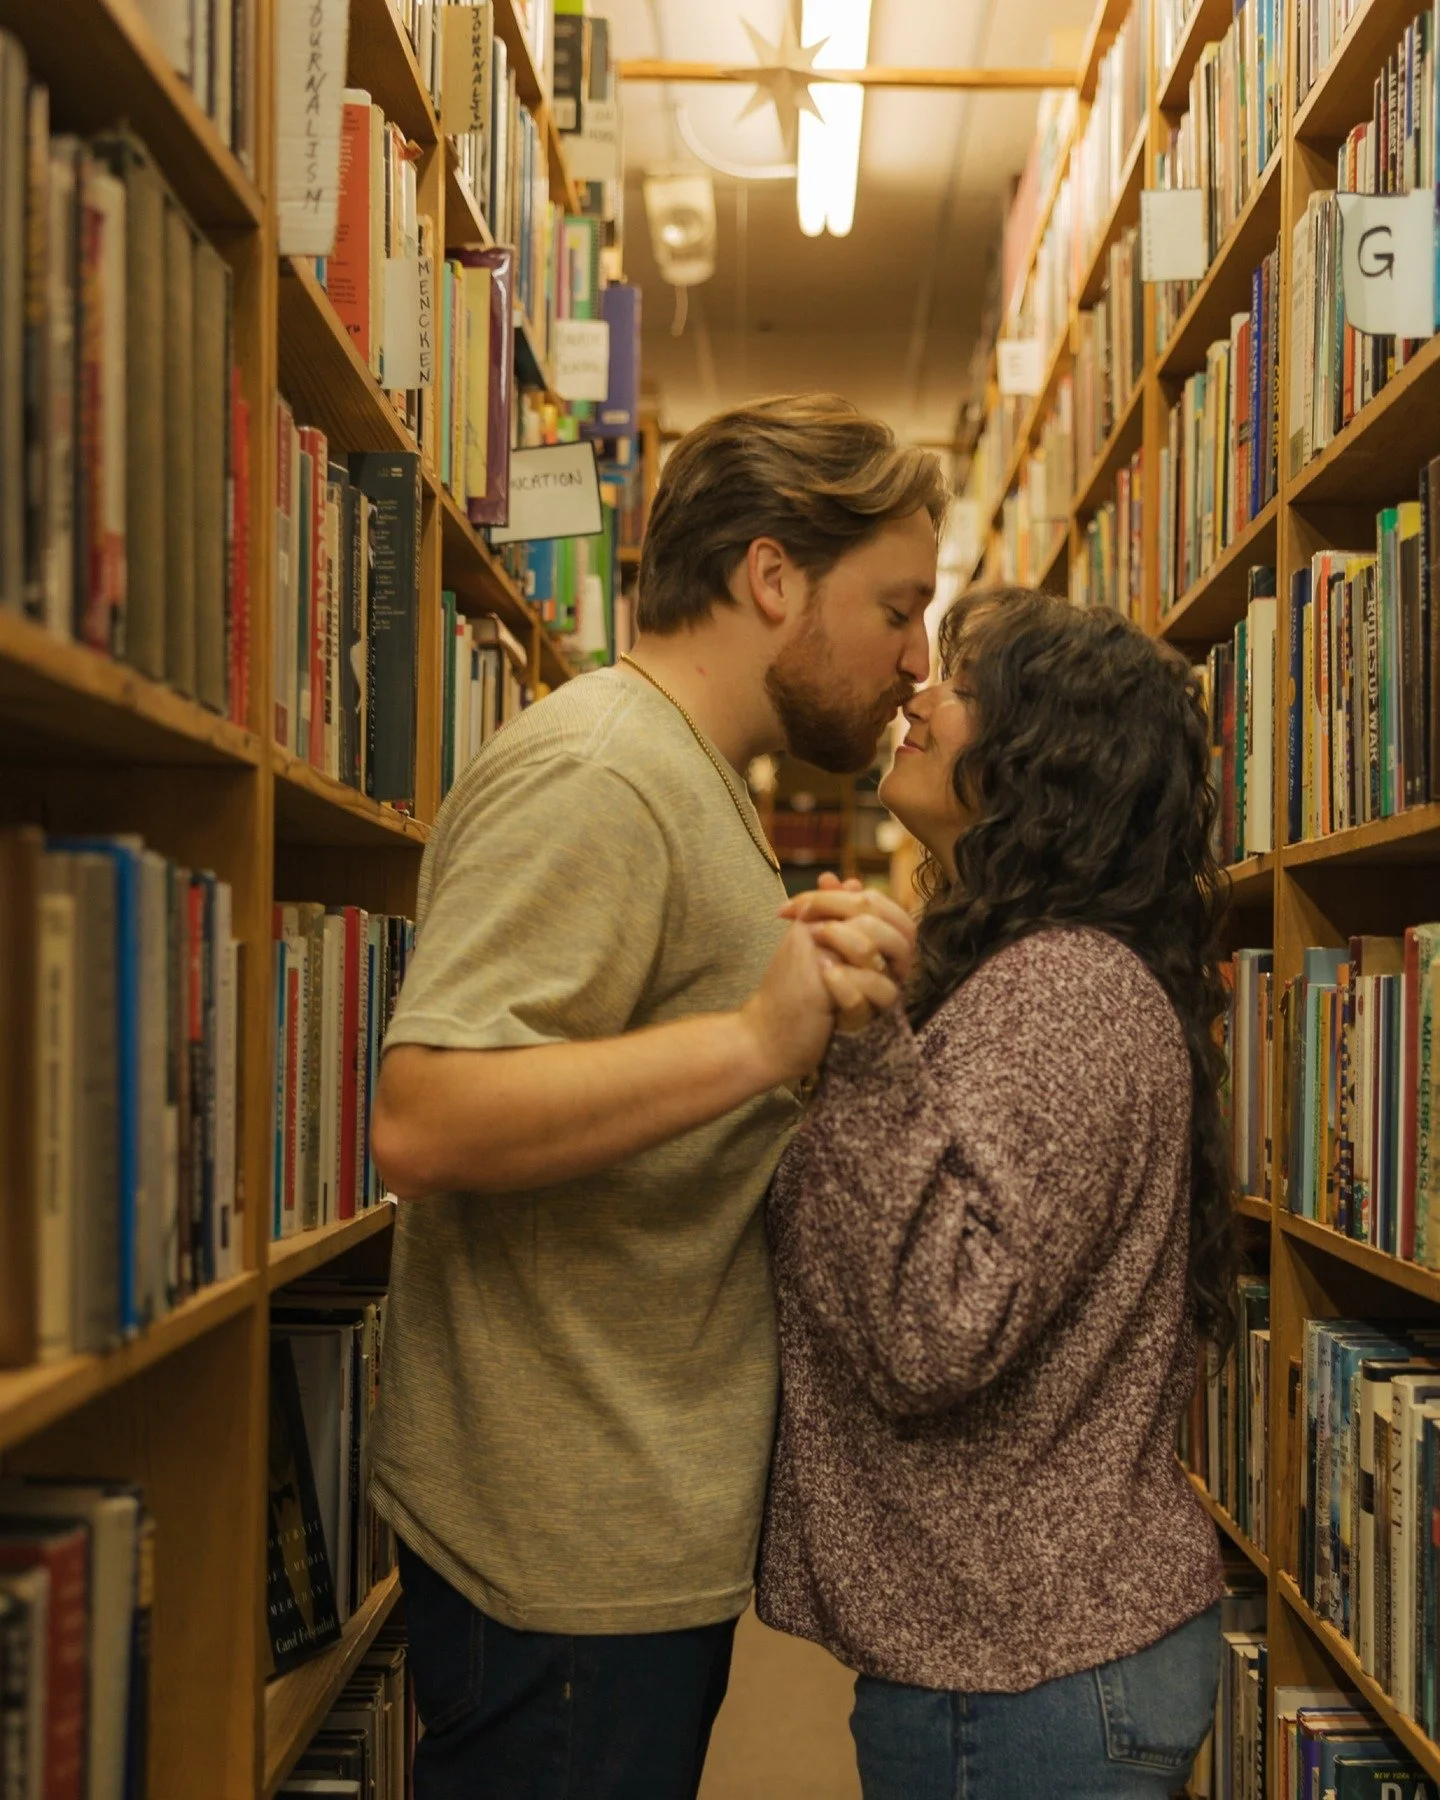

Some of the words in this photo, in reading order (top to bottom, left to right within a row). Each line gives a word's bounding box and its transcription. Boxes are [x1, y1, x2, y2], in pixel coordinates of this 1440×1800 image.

[469, 8, 486, 132] JOURNALISM
[1358, 225, 1394, 280] G
[418, 259, 432, 385] MENCKEN
[313, 437, 330, 662] MENCKEN
[1367, 600, 1379, 675] RULES
[1391, 1393, 1403, 1536] GENET
[266, 1519, 319, 1549] ORTRAIT
[1373, 1771, 1390, 1781] NEW
